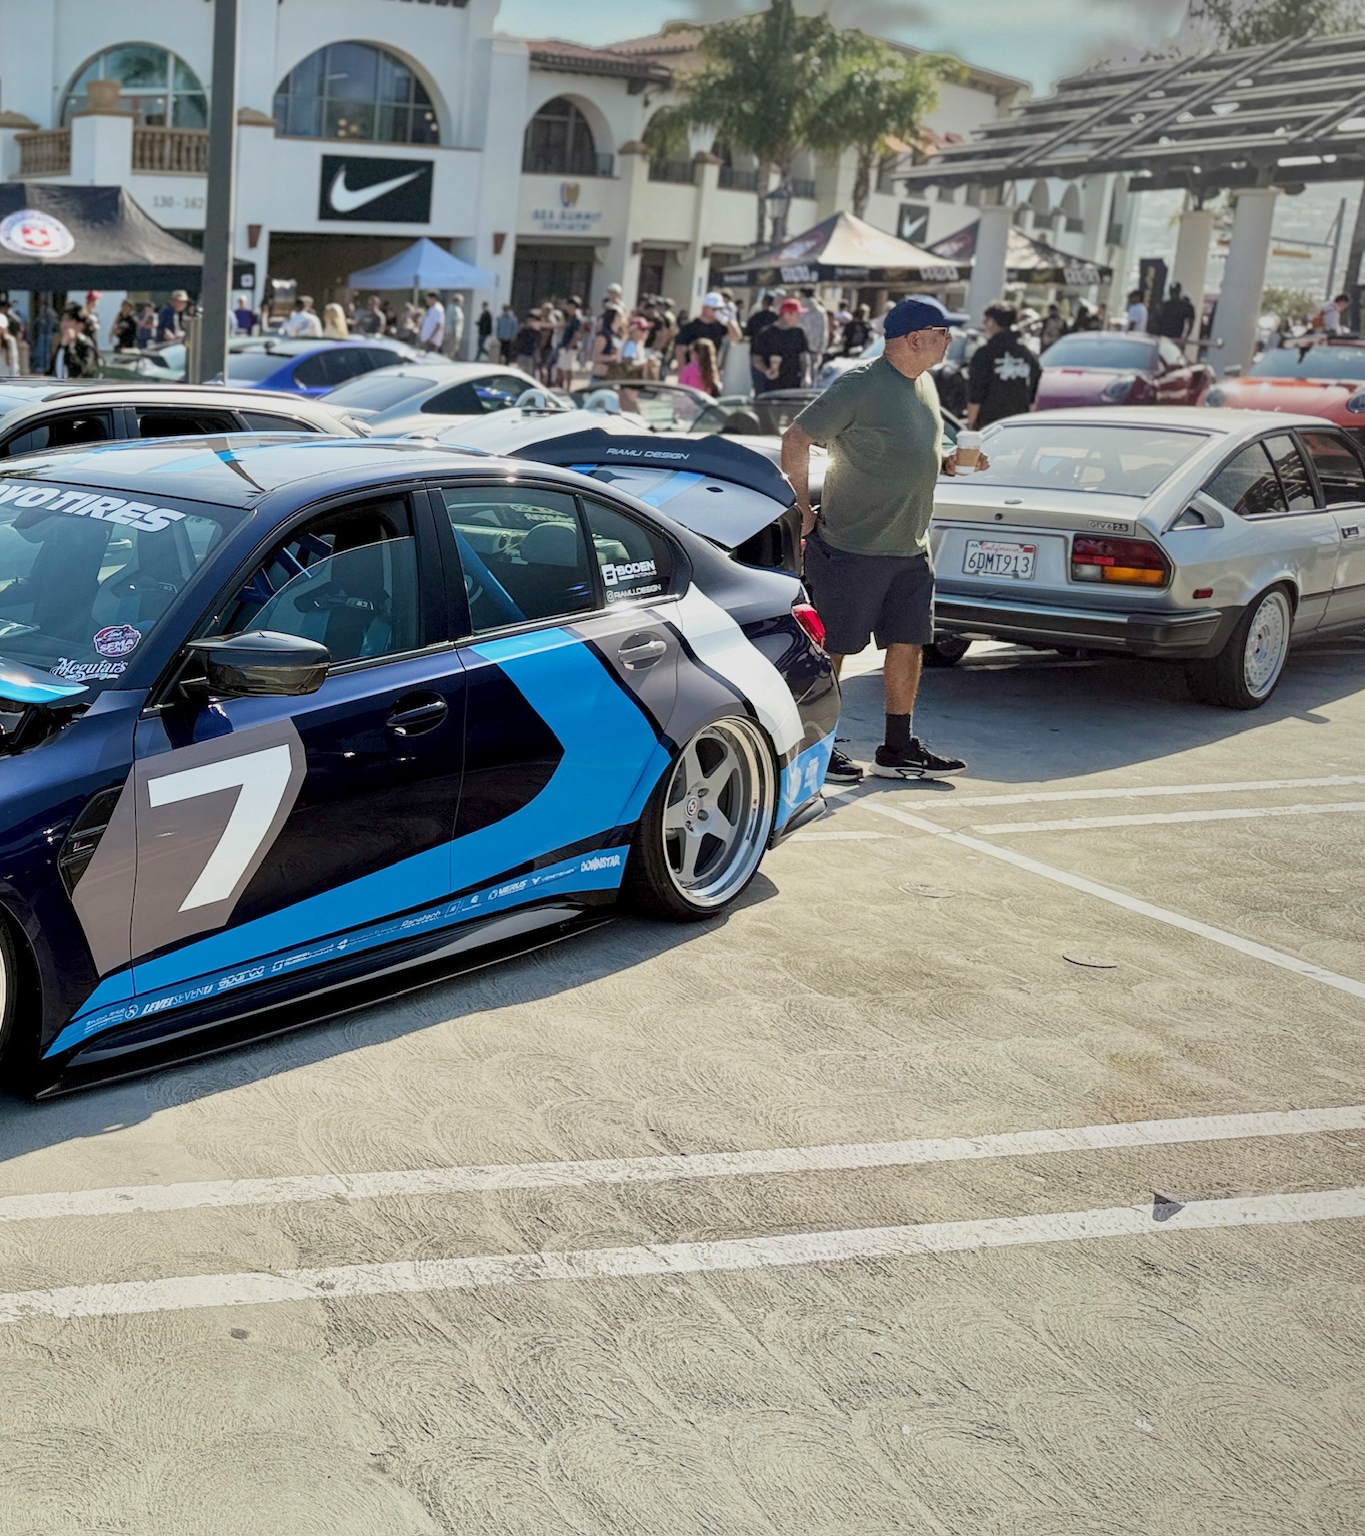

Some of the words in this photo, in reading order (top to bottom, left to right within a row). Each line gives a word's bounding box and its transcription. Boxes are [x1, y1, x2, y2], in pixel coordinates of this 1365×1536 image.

[606, 447, 643, 458] RIAMU
[644, 450, 690, 460] DESIGN
[615, 560, 656, 576] BODEN
[968, 552, 1030, 573] 6DMT913
[98, 638, 135, 652] SEMA
[49, 657, 129, 679] Meguiar's
[147, 743, 292, 913] 7
